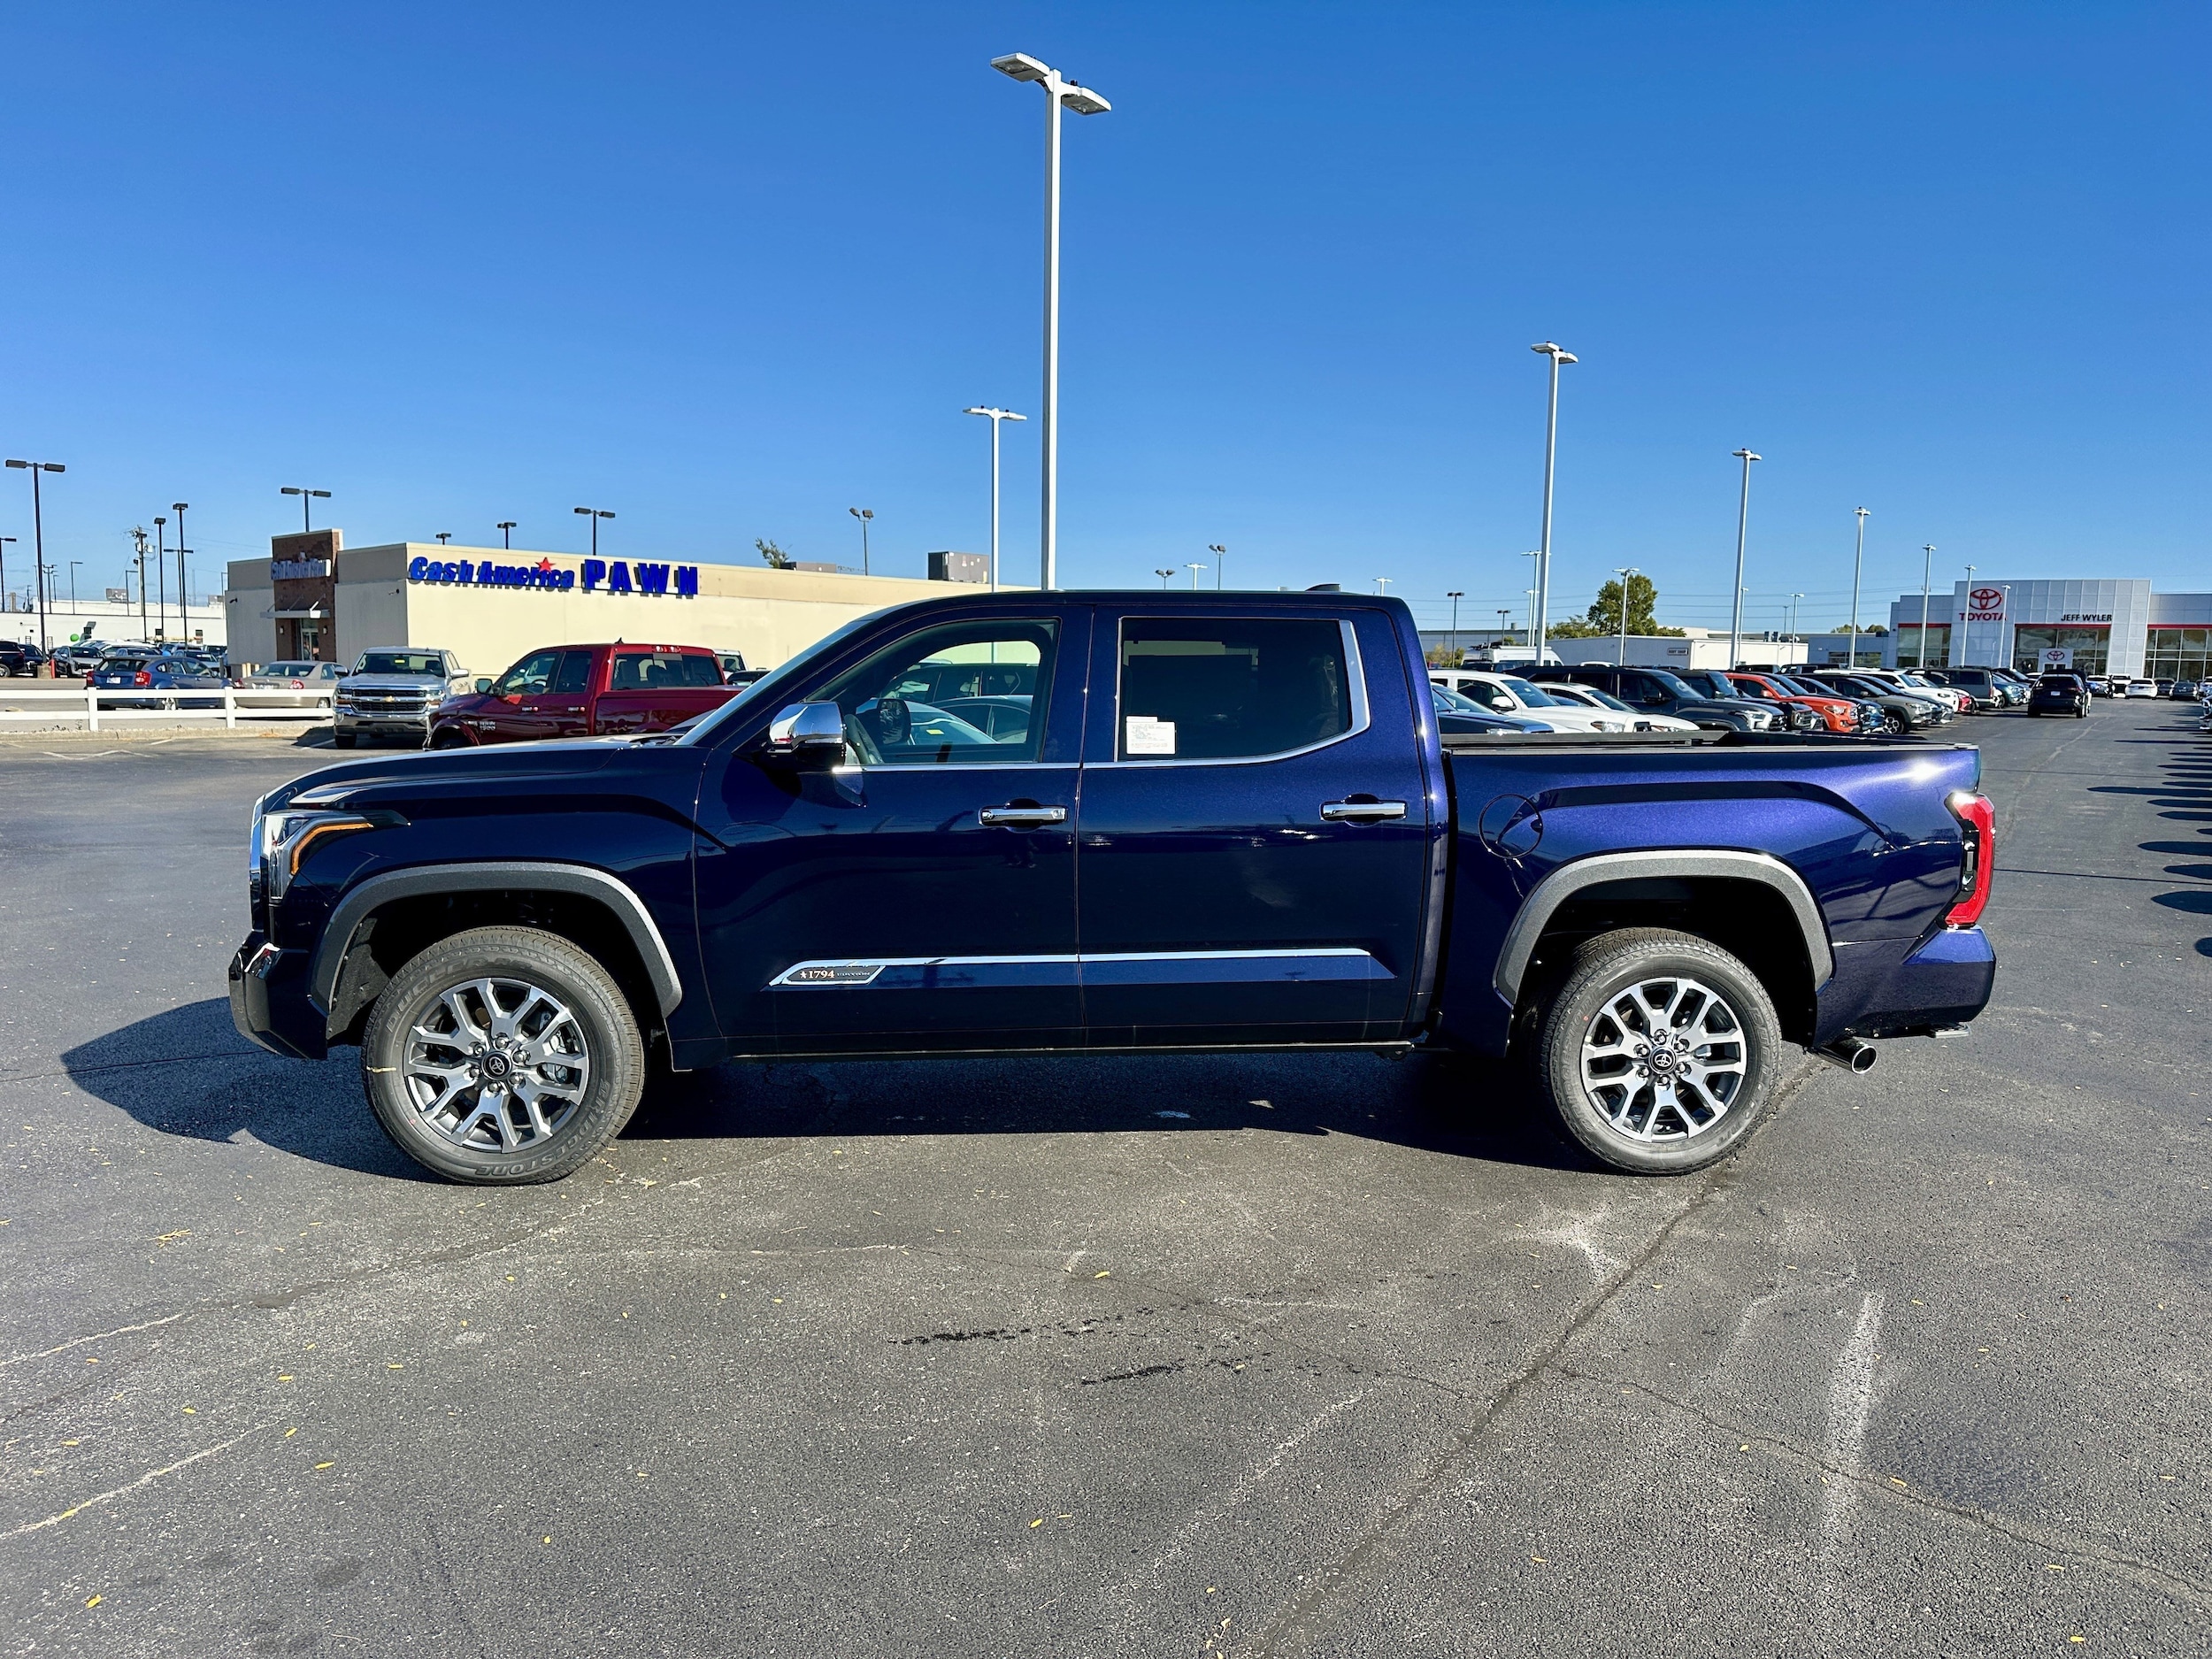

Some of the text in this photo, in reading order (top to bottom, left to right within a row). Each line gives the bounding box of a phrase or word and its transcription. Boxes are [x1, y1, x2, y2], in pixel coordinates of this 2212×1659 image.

[408, 556, 698, 595] Cash America PAWN
[1959, 612, 2007, 621] TOYOTA
[808, 970, 834, 979] 1794
[474, 1078, 611, 1177] BRIDGESTONE
